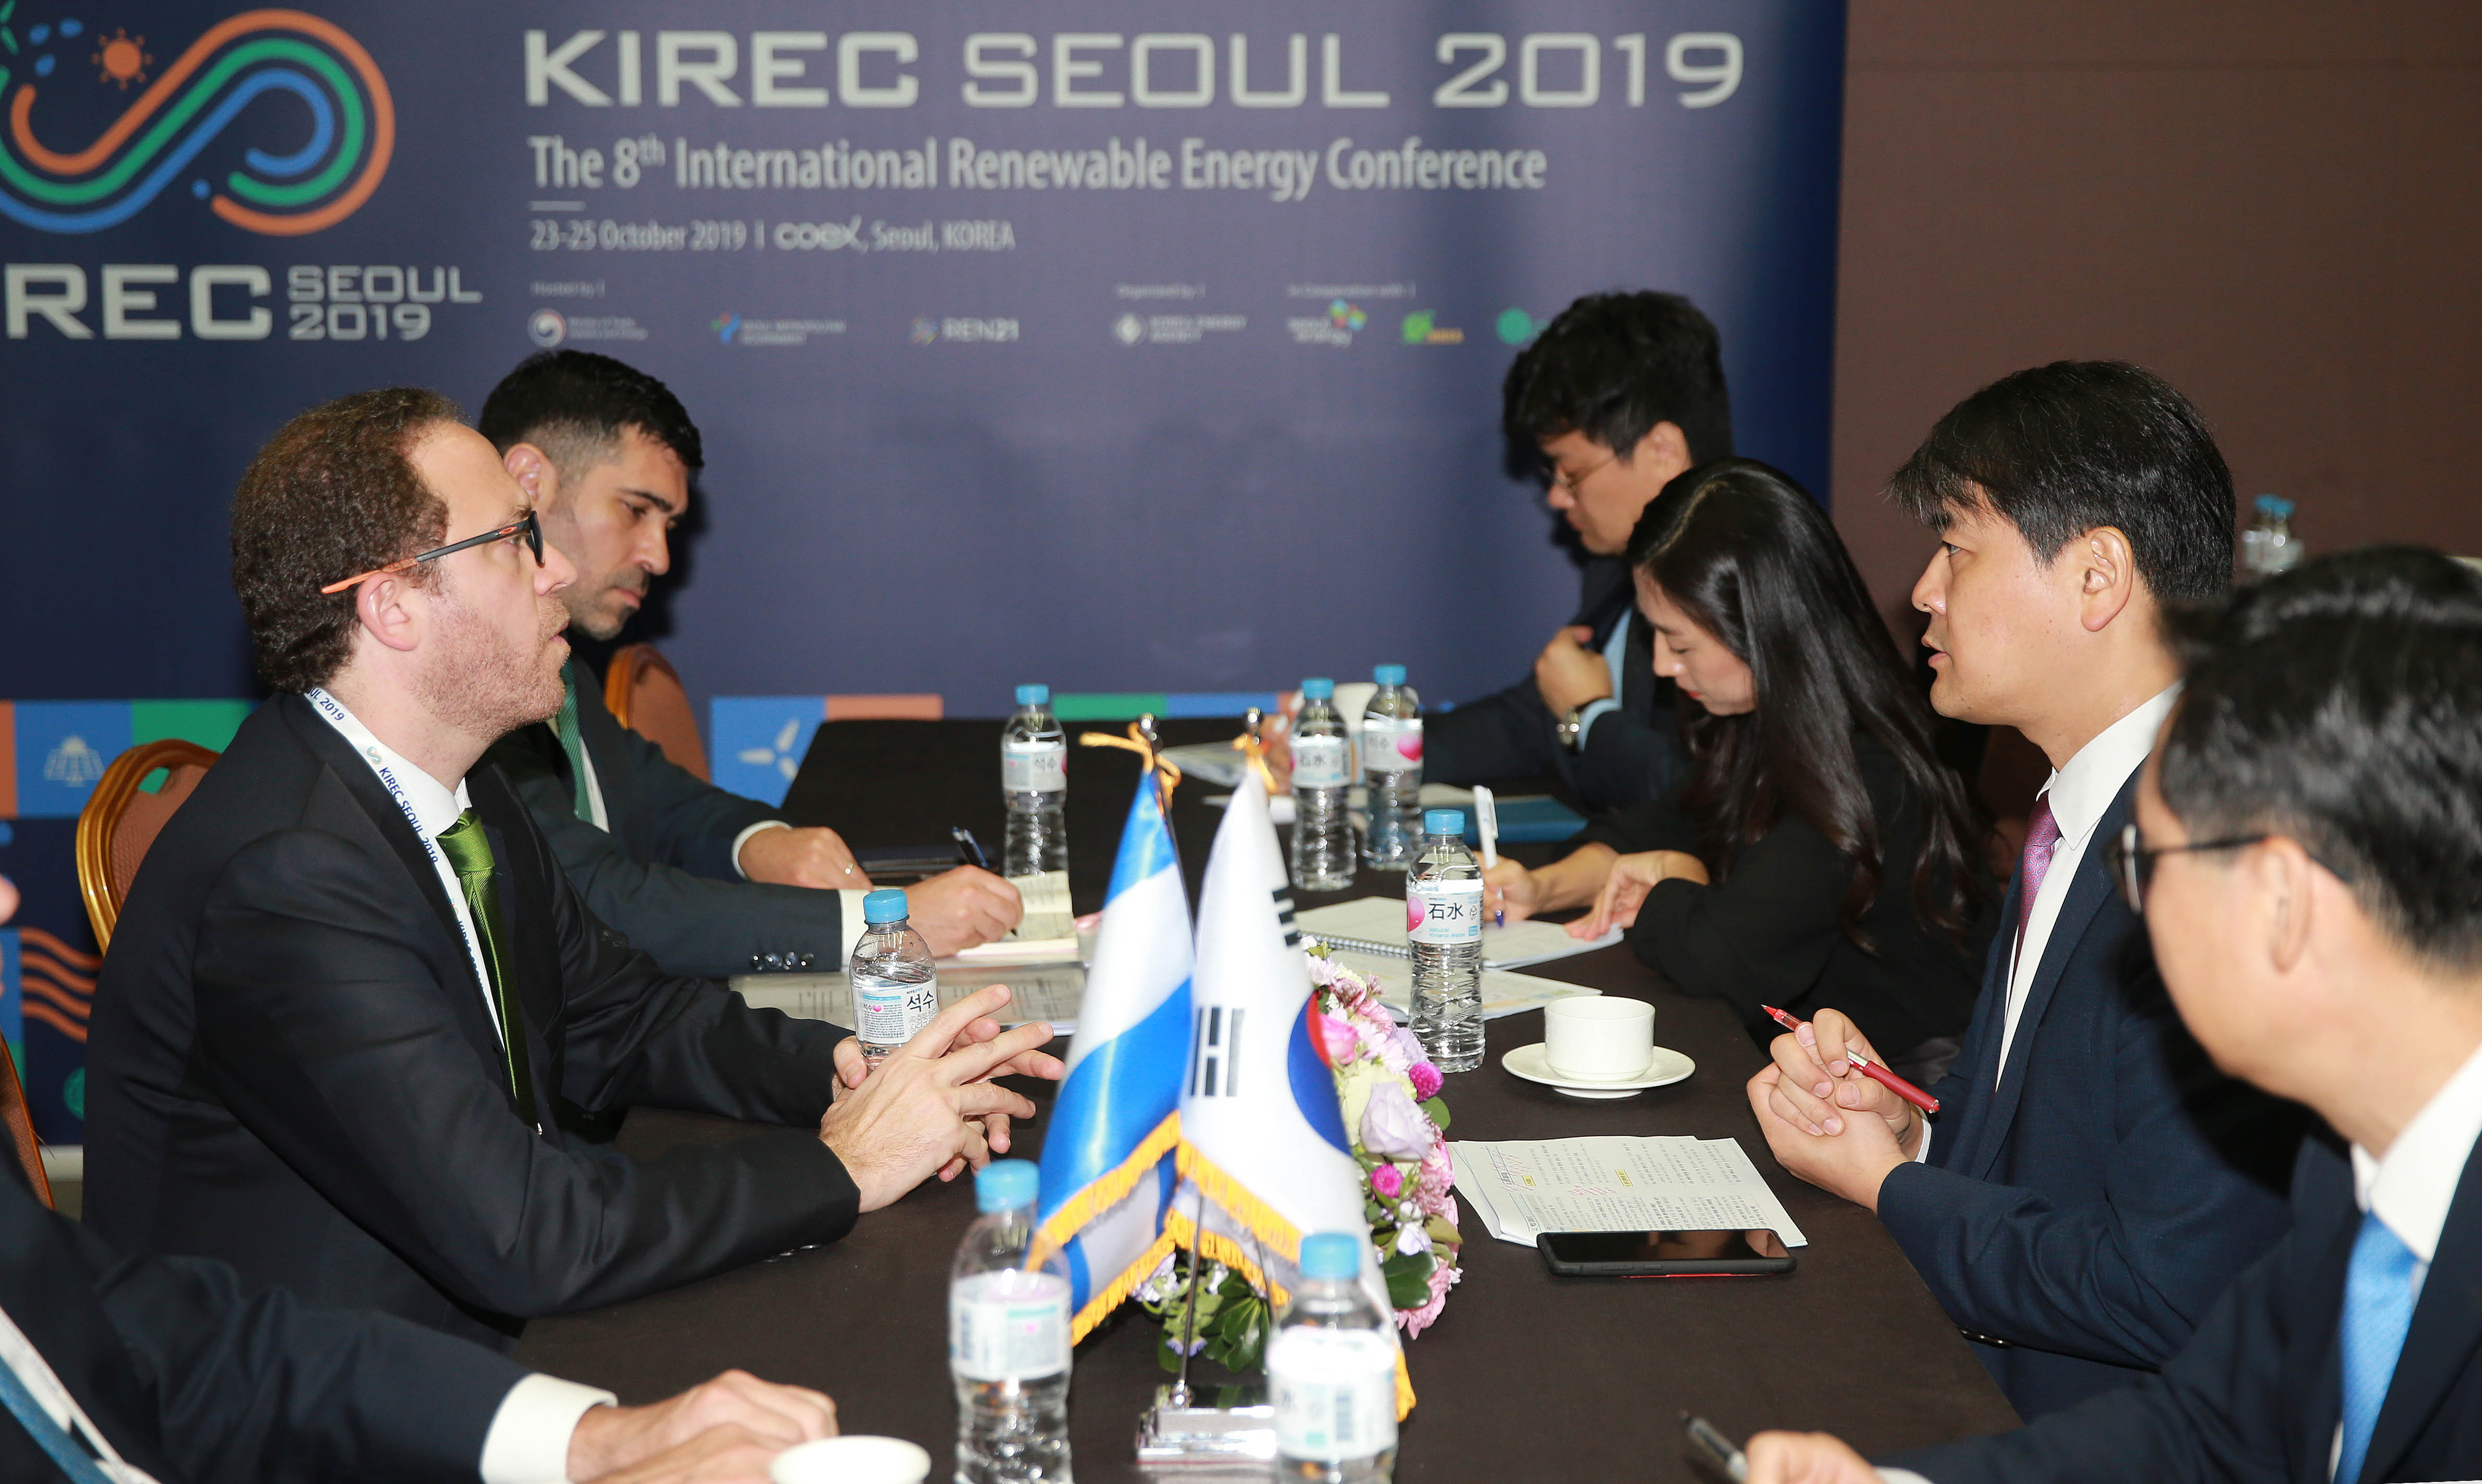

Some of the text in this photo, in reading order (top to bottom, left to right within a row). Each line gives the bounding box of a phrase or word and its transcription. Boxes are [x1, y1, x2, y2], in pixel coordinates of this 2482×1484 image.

[524, 30, 1743, 108] KIREC SEOUL 2019
[528, 134, 1548, 201] The 8th International Renewable Energy Conference
[529, 219, 597, 251] 23-25
[598, 218, 687, 251] October
[690, 219, 748, 251] 2019
[942, 220, 1016, 251] KOREA
[287, 265, 484, 303] SEOUL
[288, 304, 432, 340] 2019
[941, 318, 1020, 342] REN21
[319, 697, 345, 720] 2019
[379, 767, 404, 800] KIREC
[1429, 902, 1464, 920] 石水
[907, 990, 934, 1012] 석수
